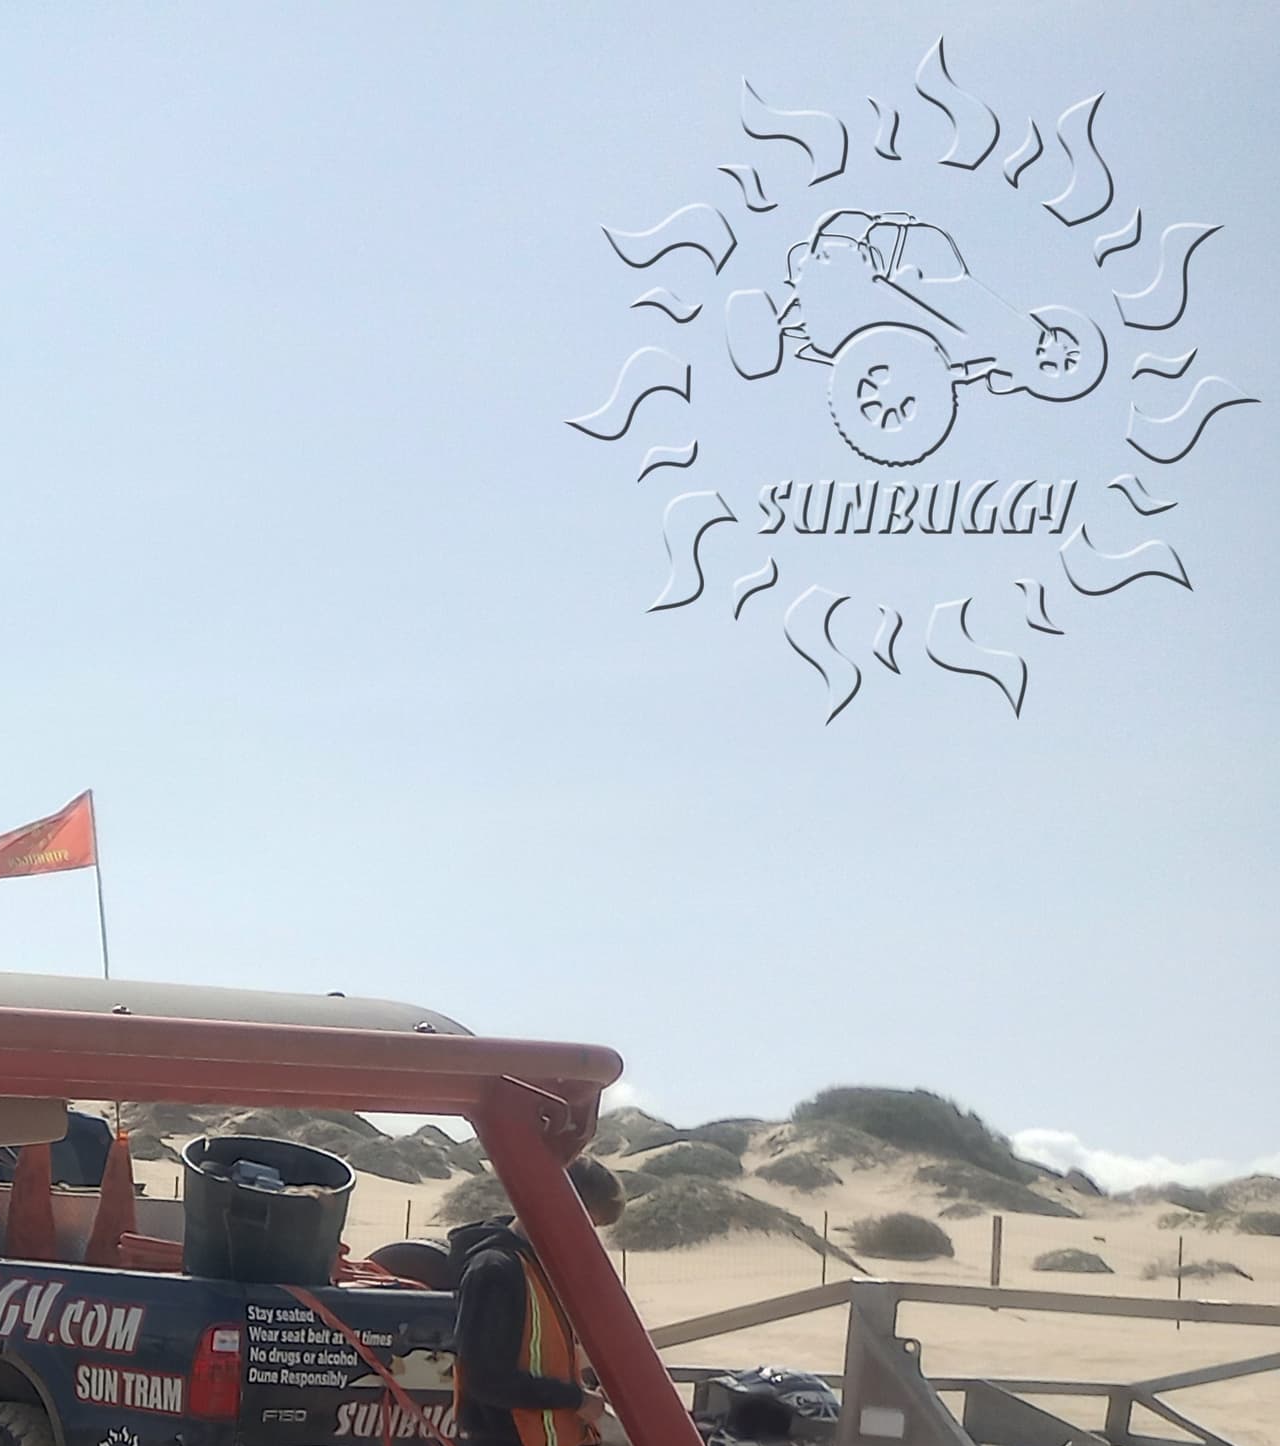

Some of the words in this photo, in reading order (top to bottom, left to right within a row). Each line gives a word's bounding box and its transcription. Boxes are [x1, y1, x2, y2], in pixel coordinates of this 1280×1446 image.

[247, 1304, 274, 1324] Stay
[275, 1307, 315, 1324] seated
[248, 1326, 280, 1343] Wear
[281, 1328, 306, 1344] seat
[307, 1327, 331, 1345] belt
[362, 1330, 393, 1347] times
[249, 1346, 268, 1363] No
[268, 1347, 302, 1367] drugs
[303, 1351, 317, 1365] or
[317, 1349, 359, 1367] alcohol
[76, 1364, 119, 1405] SUN
[122, 1370, 184, 1414] TRAM
[248, 1368, 279, 1385] Dune
[280, 1369, 348, 1390] Responsibly
